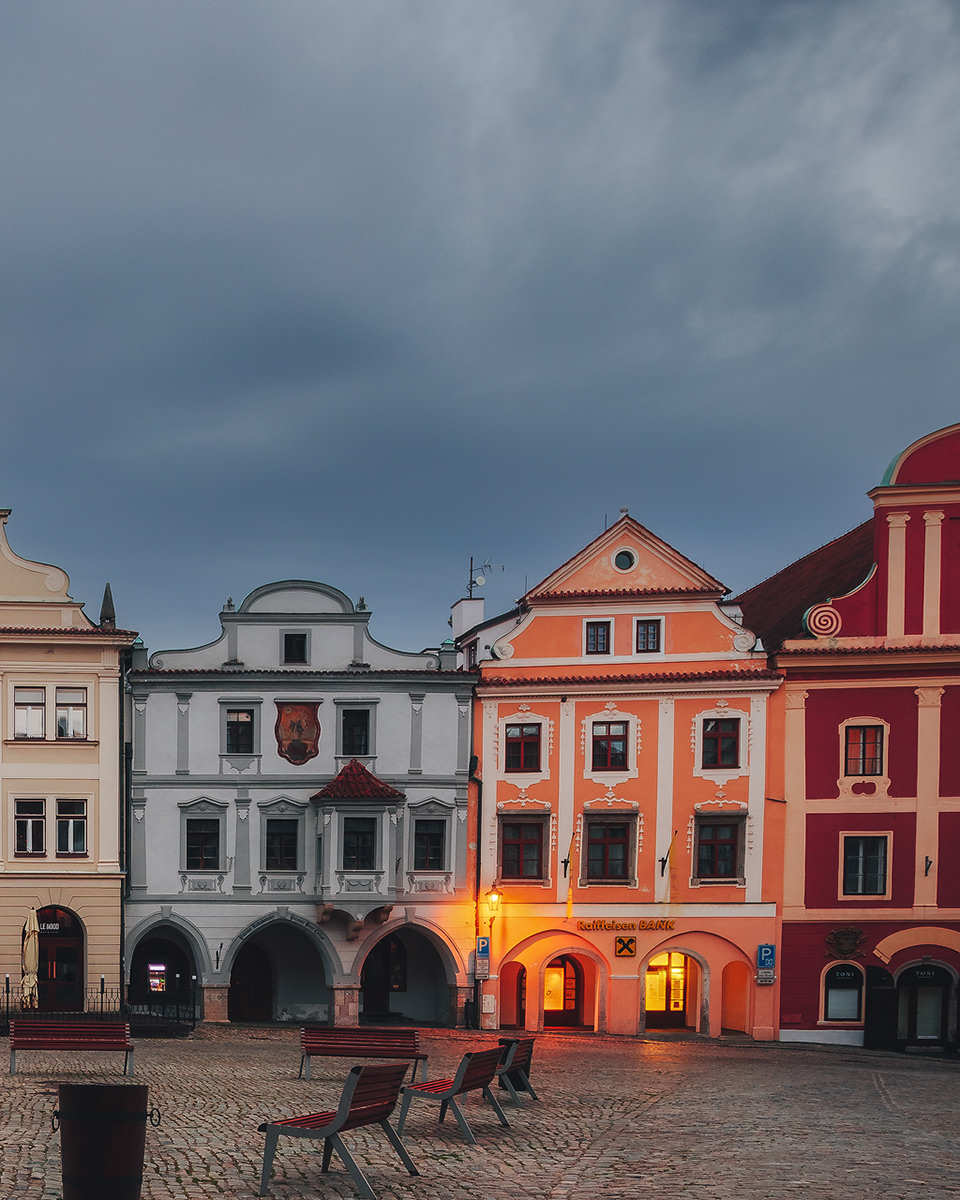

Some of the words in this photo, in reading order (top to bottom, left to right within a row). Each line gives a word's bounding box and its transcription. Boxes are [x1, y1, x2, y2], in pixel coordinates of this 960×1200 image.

[577, 920, 637, 930] Raiffeisen
[639, 920, 676, 930] BANK
[479, 939, 488, 952] P
[761, 947, 772, 961] P
